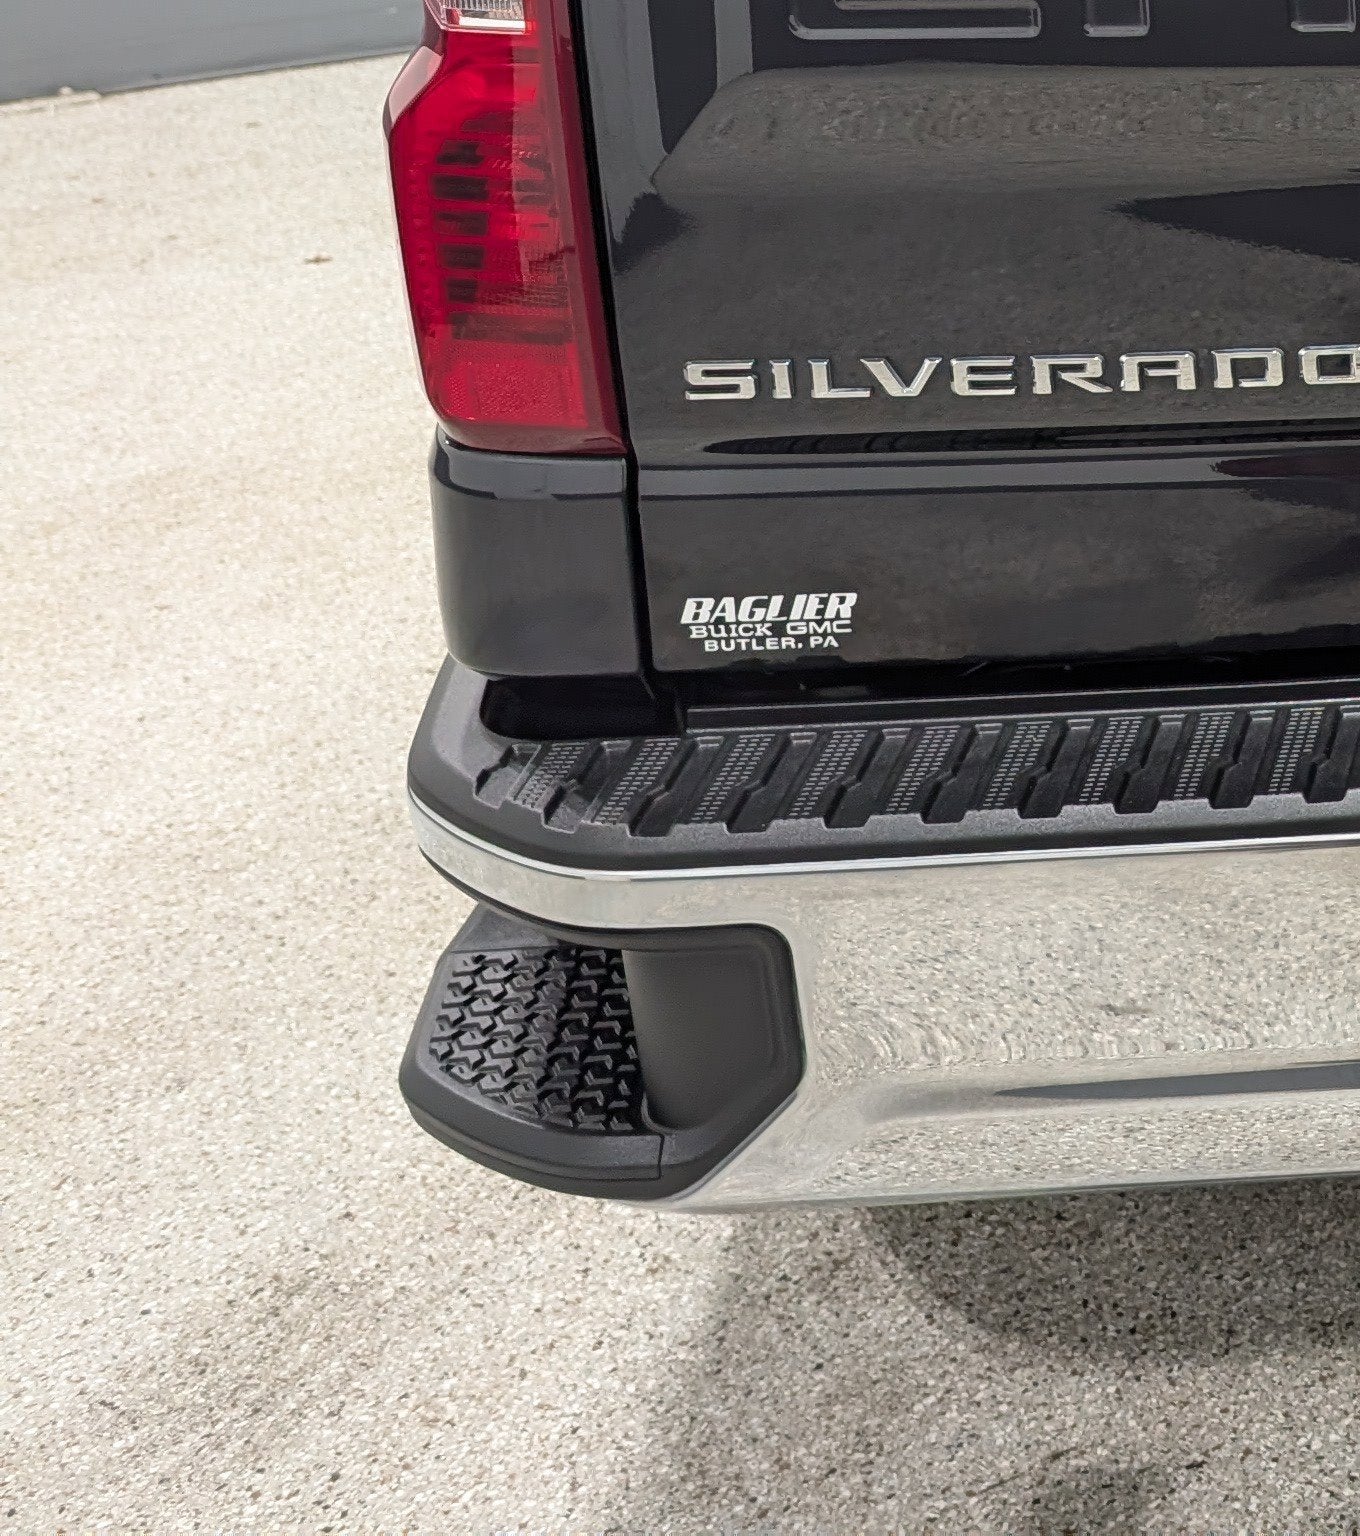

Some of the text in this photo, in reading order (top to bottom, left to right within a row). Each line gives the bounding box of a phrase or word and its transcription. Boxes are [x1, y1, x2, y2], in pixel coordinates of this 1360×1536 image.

[680, 592, 858, 624] BAGLIER
[690, 619, 853, 639] BUICK GMC
[810, 635, 839, 649] PA
